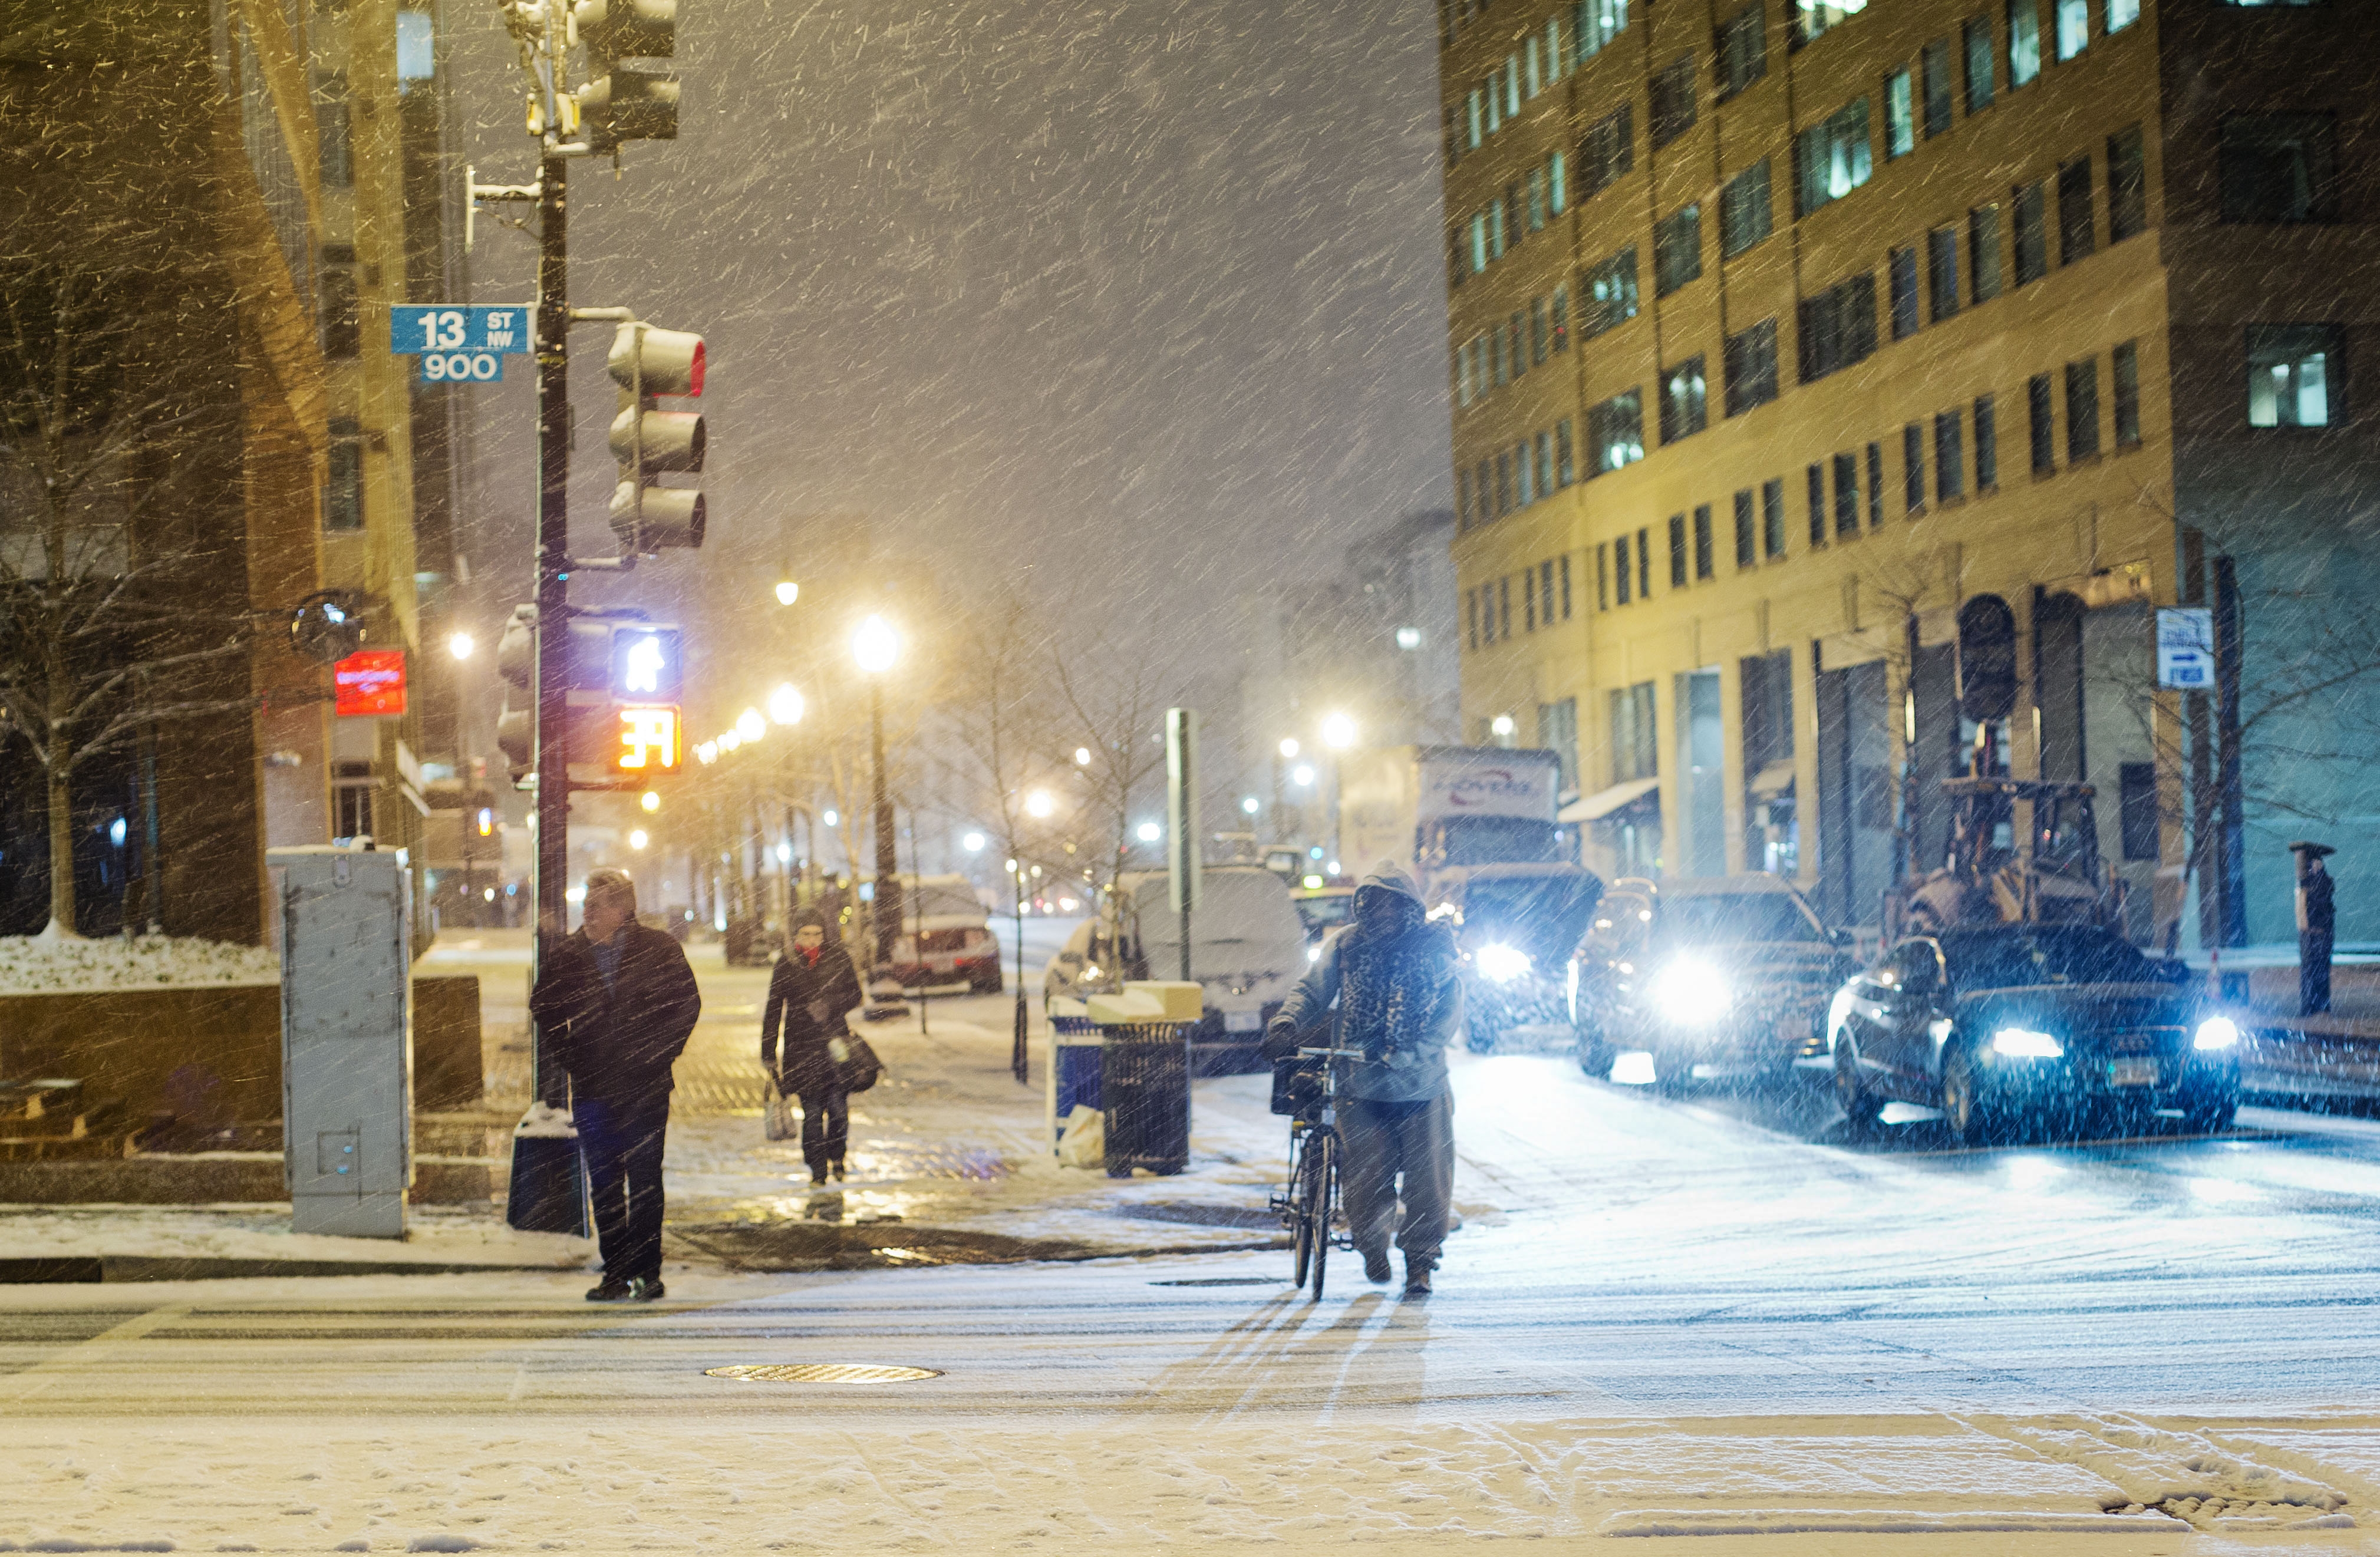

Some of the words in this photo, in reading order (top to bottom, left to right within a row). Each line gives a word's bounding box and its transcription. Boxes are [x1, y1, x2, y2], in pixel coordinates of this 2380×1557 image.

[418, 311, 466, 348] 13
[487, 312, 515, 329] ST
[487, 331, 514, 347] NW
[425, 354, 497, 380] 900
[619, 710, 674, 767] 39
